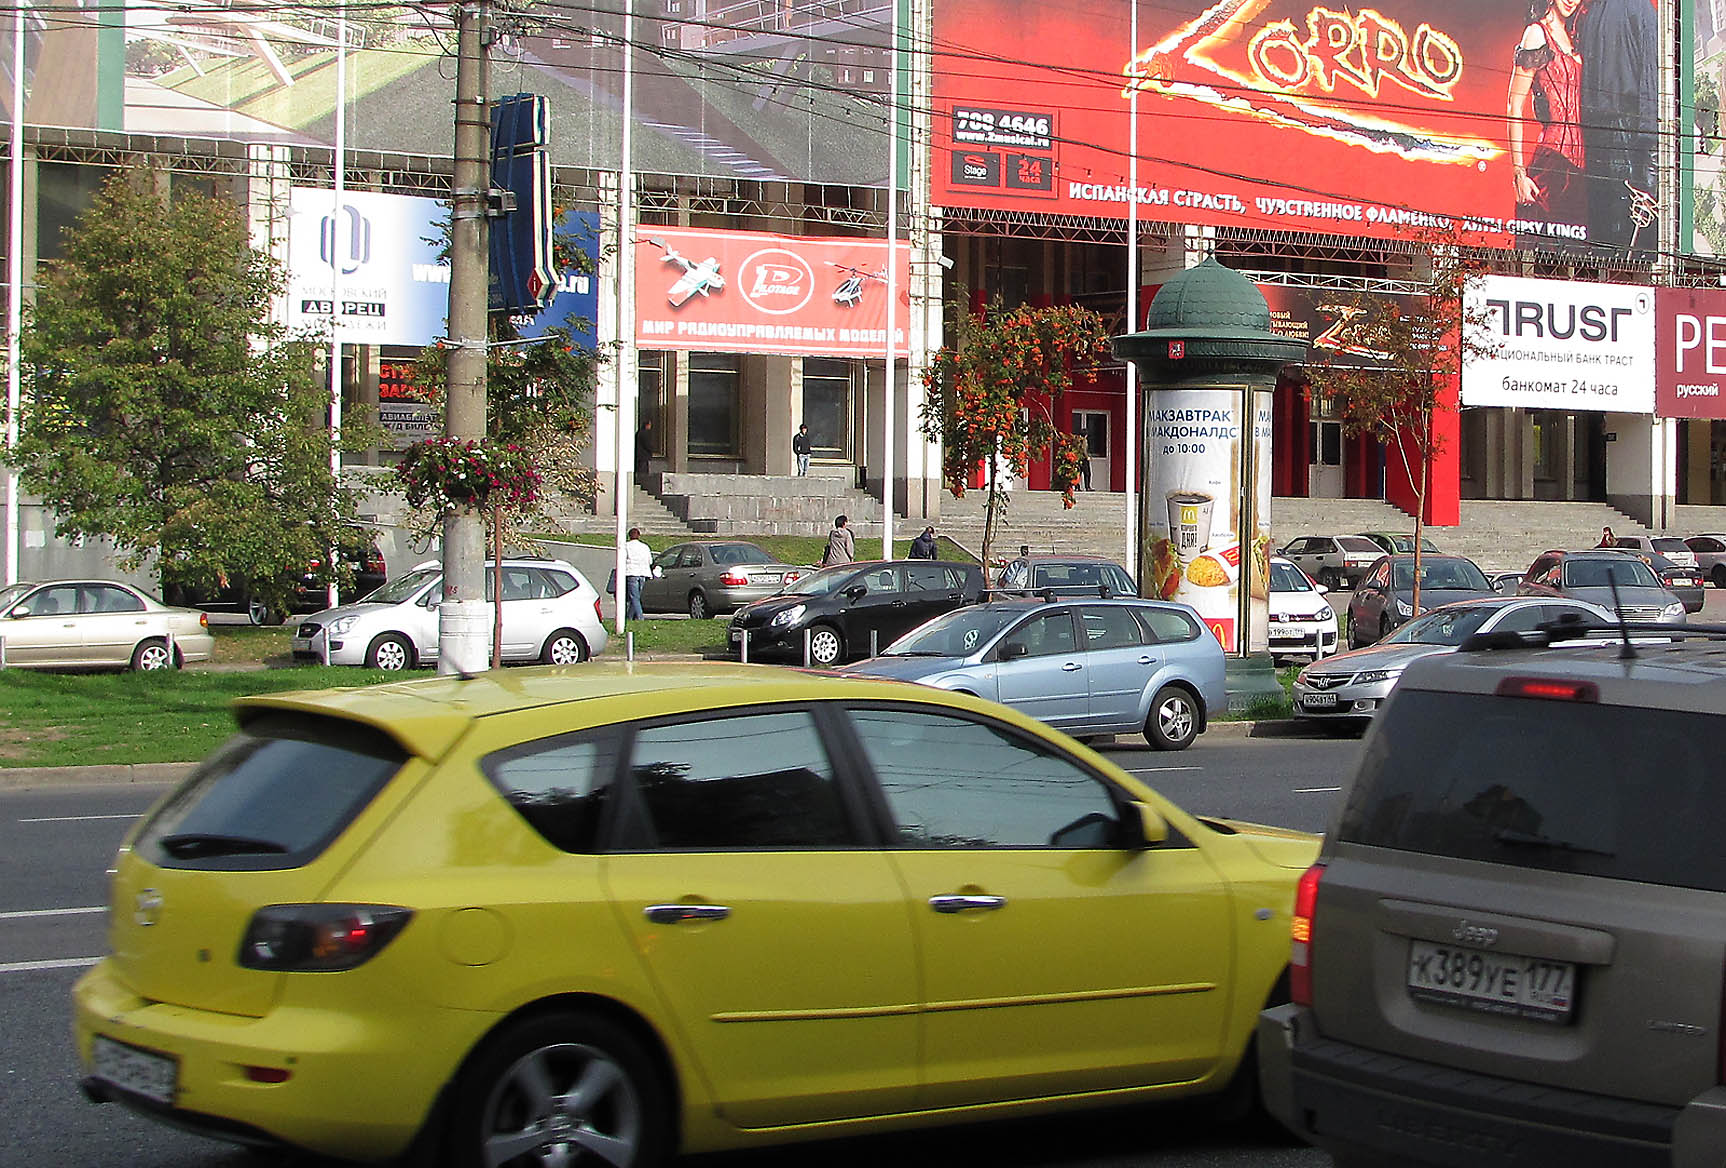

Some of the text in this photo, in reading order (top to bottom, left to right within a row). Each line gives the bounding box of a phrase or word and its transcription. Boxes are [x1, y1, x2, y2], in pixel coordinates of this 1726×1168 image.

[998, 115, 1049, 136] 4646
[1018, 159, 1042, 176] 24
[1173, 190, 1246, 214] СТРАСТЬ,
[1256, 197, 1363, 221] ЧУВСТВЕННОЕ
[1547, 222, 1588, 241] KINGS
[306, 301, 381, 316] ДВРЕЦ
[643, 320, 905, 344] МИР РАДИОУПРАВЛЯЕМЫХ МОДЕЛЙ
[1575, 353, 1602, 364] БАНК
[1604, 354, 1634, 366] ТРАСТ
[1502, 376, 1618, 396] банкомат 24 часа
[1676, 383, 1719, 398] русский
[1162, 443, 1206, 455] до 10:00
[1525, 962, 1567, 992] 177
